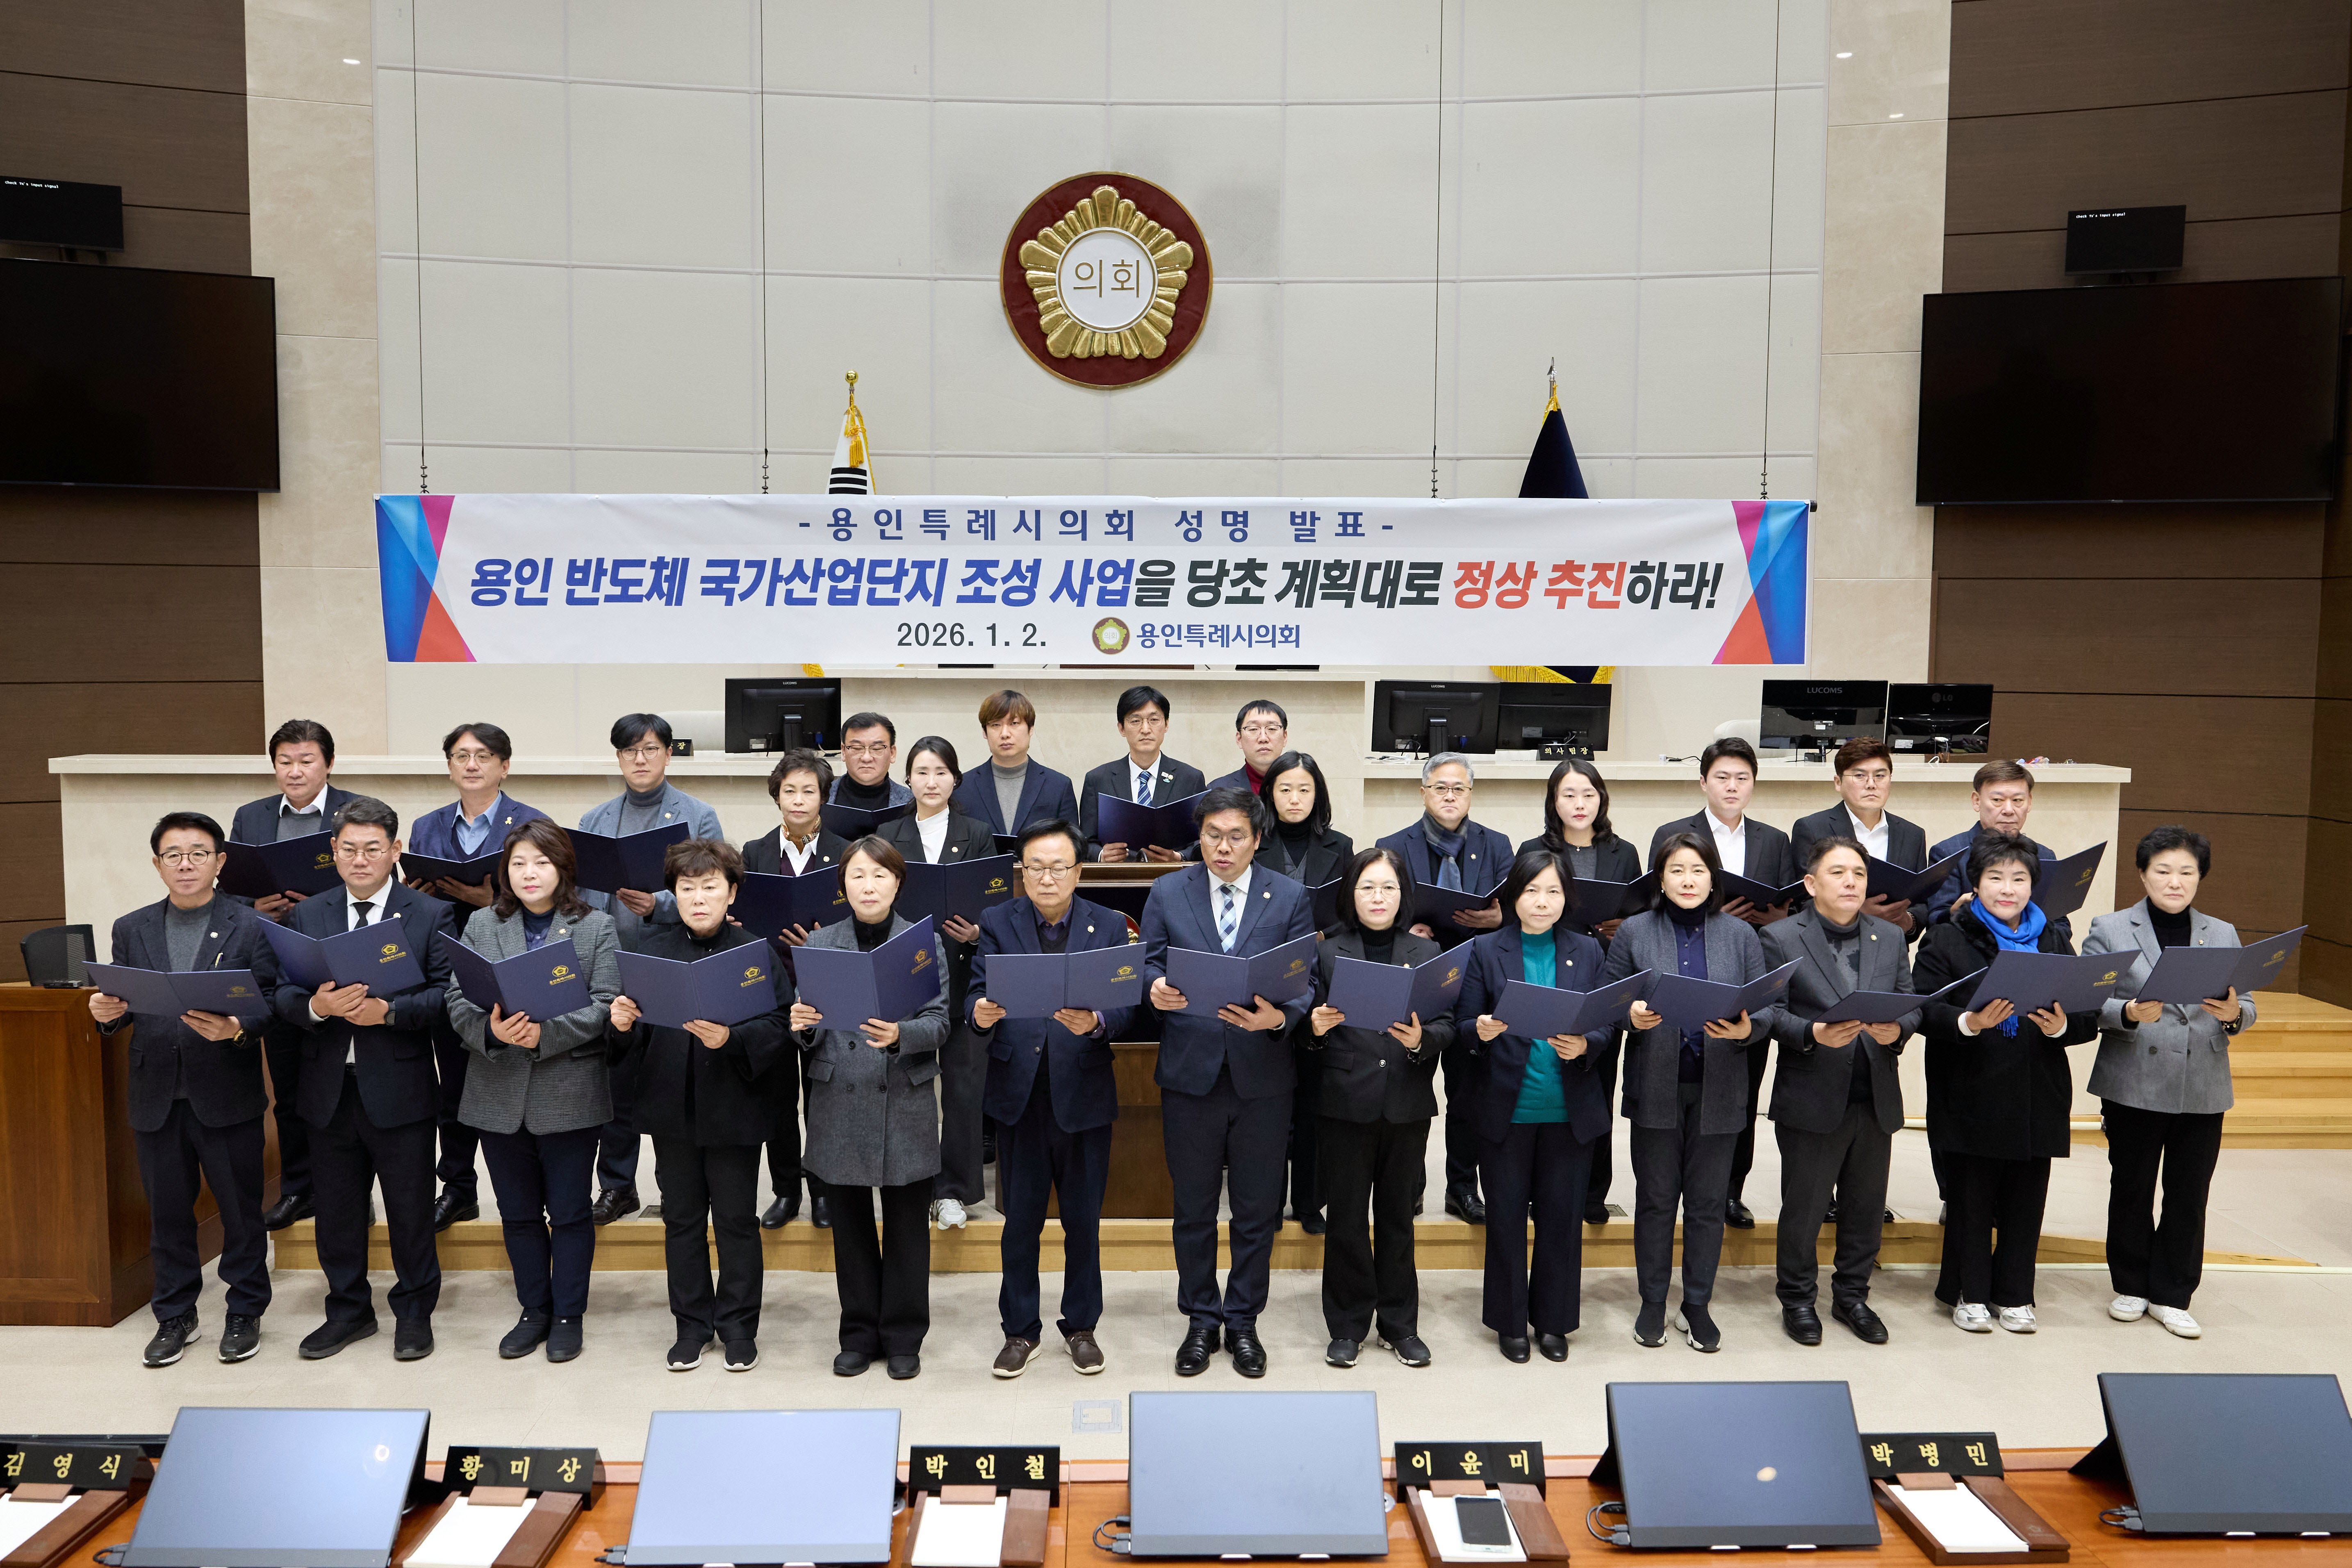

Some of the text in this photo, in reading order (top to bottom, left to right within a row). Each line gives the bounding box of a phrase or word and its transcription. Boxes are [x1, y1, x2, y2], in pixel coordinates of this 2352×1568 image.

[1073, 259, 1140, 298] 의회
[1175, 511, 1249, 543] 성명
[471, 557, 1724, 610] 용인 반도체 국가산업단지 조성 사업을 당초 계획대로 정상 추진하라!
[898, 623, 1046, 647] 2026. 1. 2.
[1137, 624, 1300, 649] 용인특례시의회
[3, 1452, 121, 1480] 김영식
[925, 1454, 1045, 1480] 박인철
[1412, 1450, 1529, 1475] 이윤미
[1870, 1442, 1988, 1468] 박병민
[460, 1455, 582, 1483] 황미상
